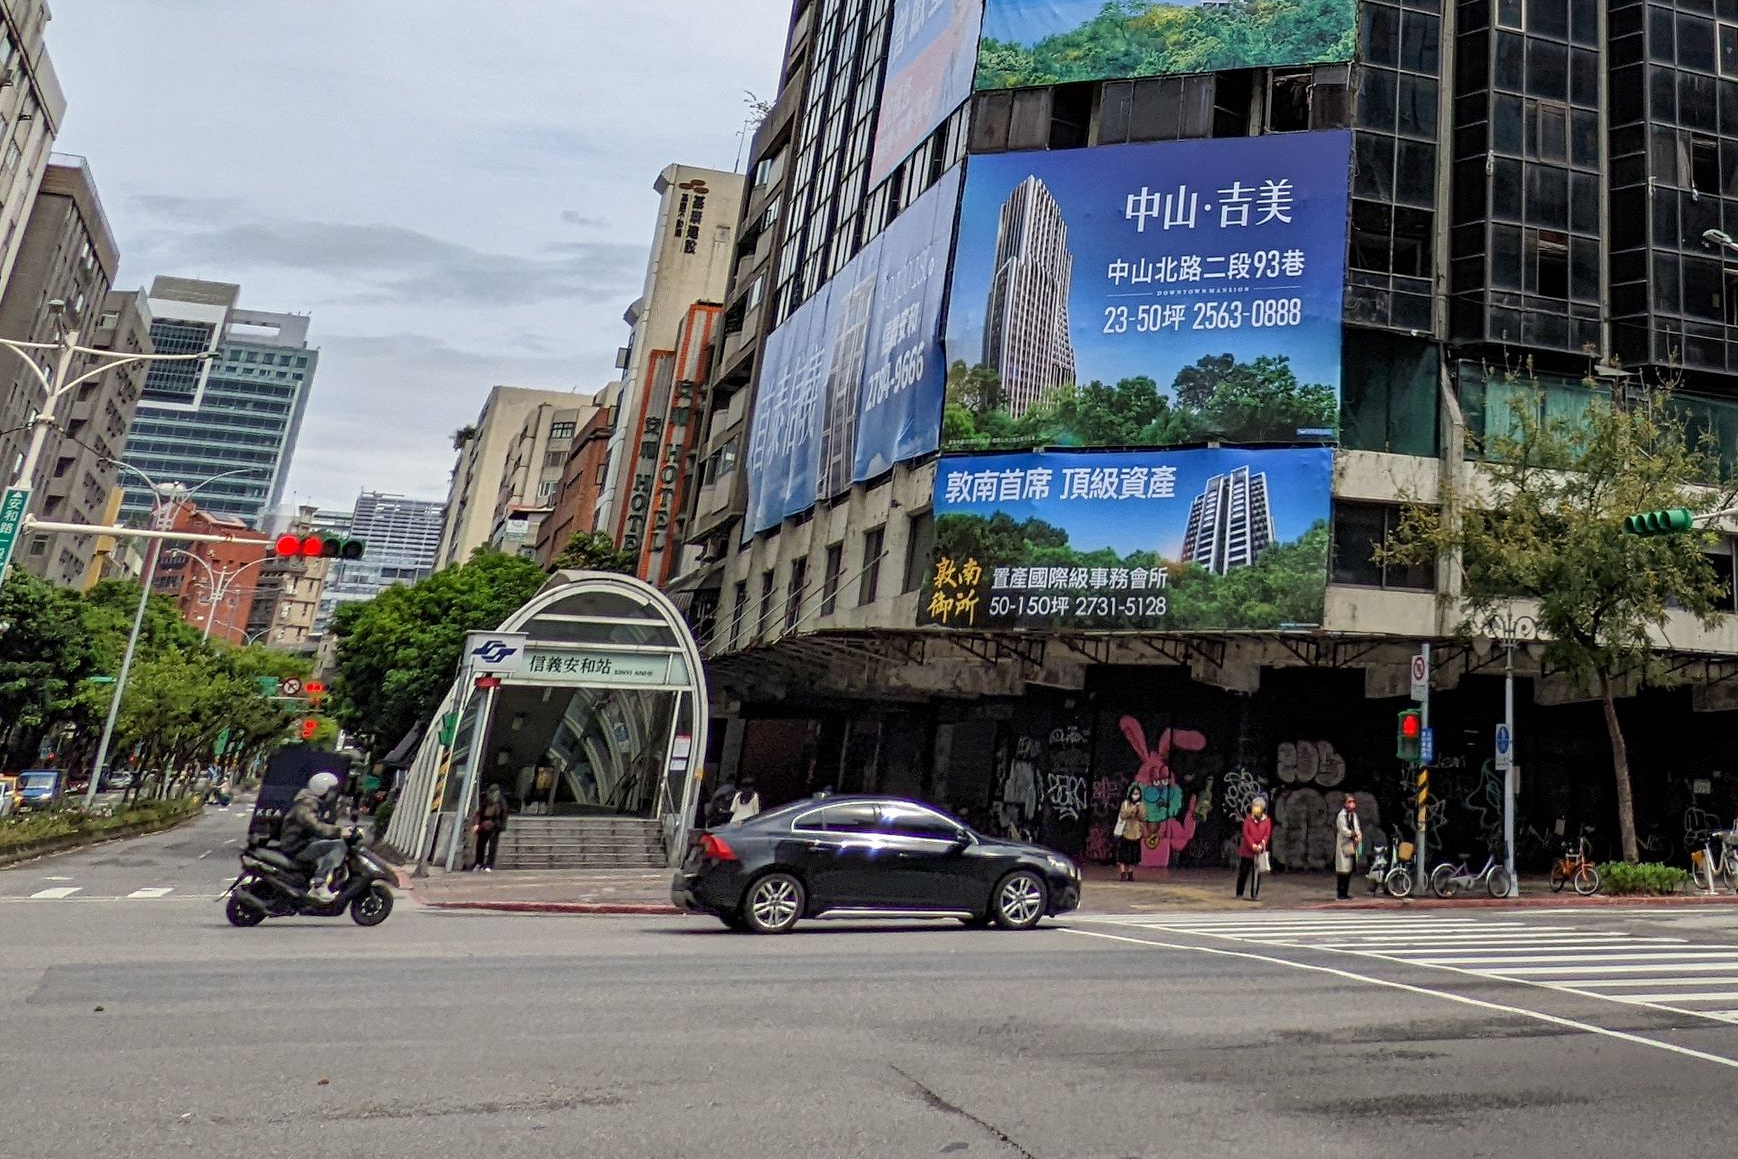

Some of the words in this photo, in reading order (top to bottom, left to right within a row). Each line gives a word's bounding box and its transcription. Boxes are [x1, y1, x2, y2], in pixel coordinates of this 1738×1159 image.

[1124, 178, 1294, 233] 中山·吉美
[1107, 248, 1305, 286] 中山北路二段93巷
[1103, 304, 1186, 335] 23-50坪
[1192, 298, 1302, 330] 2563-0888
[945, 468, 1053, 504] 敦南首席
[1059, 466, 1177, 501] 頂級資產
[622, 474, 652, 552] HOTE
[934, 557, 982, 587] 敦南
[992, 566, 1168, 590] 置產國際級事務會所
[989, 596, 1069, 616] 50-150坪
[1075, 596, 1167, 616] 2731-5128
[529, 655, 612, 675] 信義安和站
